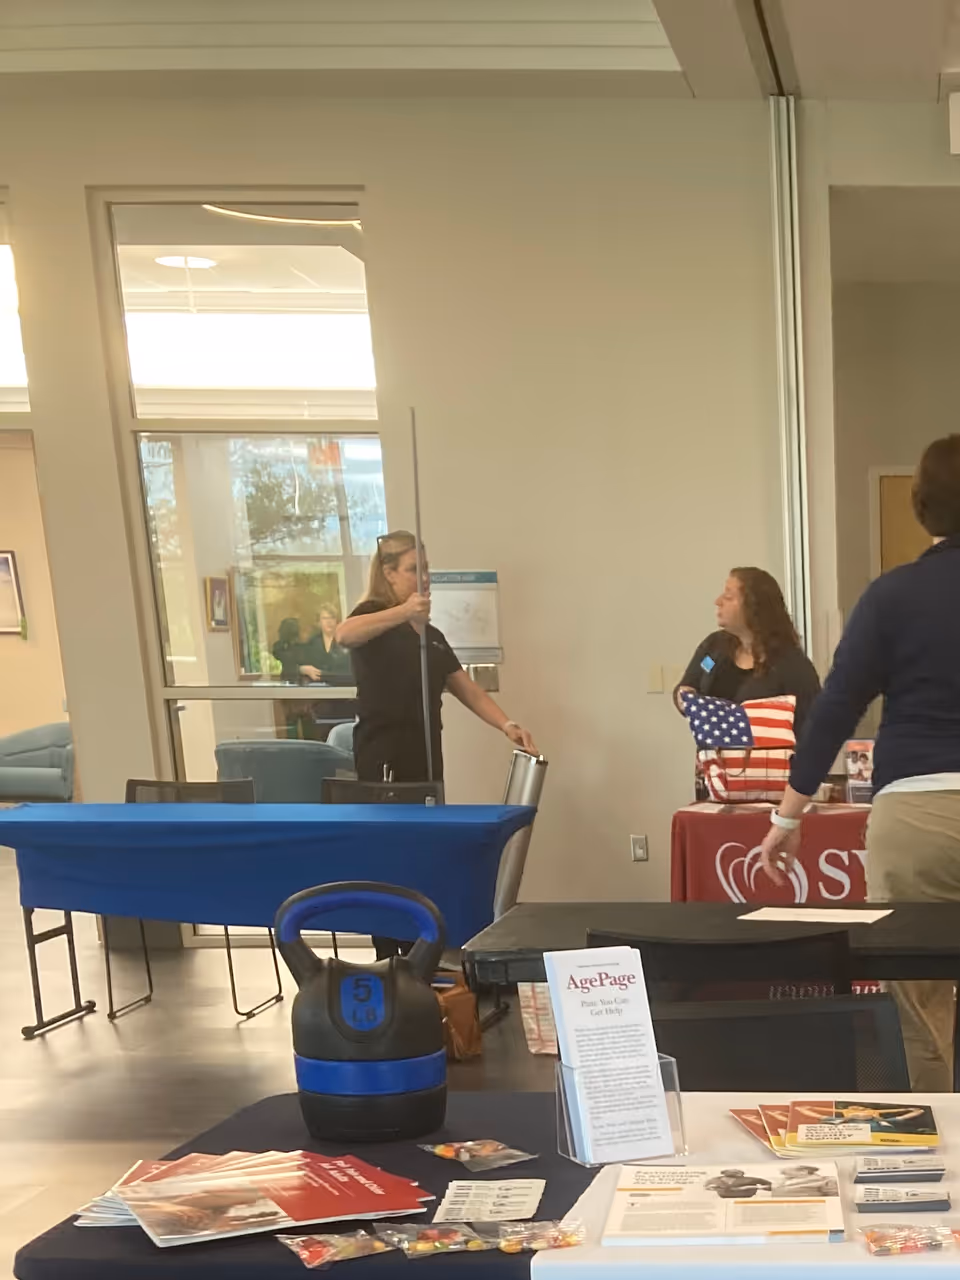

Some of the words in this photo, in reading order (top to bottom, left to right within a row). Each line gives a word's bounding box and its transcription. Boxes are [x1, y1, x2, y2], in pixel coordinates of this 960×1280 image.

[354, 978, 372, 1002] 5
[566, 972, 636, 994] AgePage
[352, 1006, 378, 1022] LB
